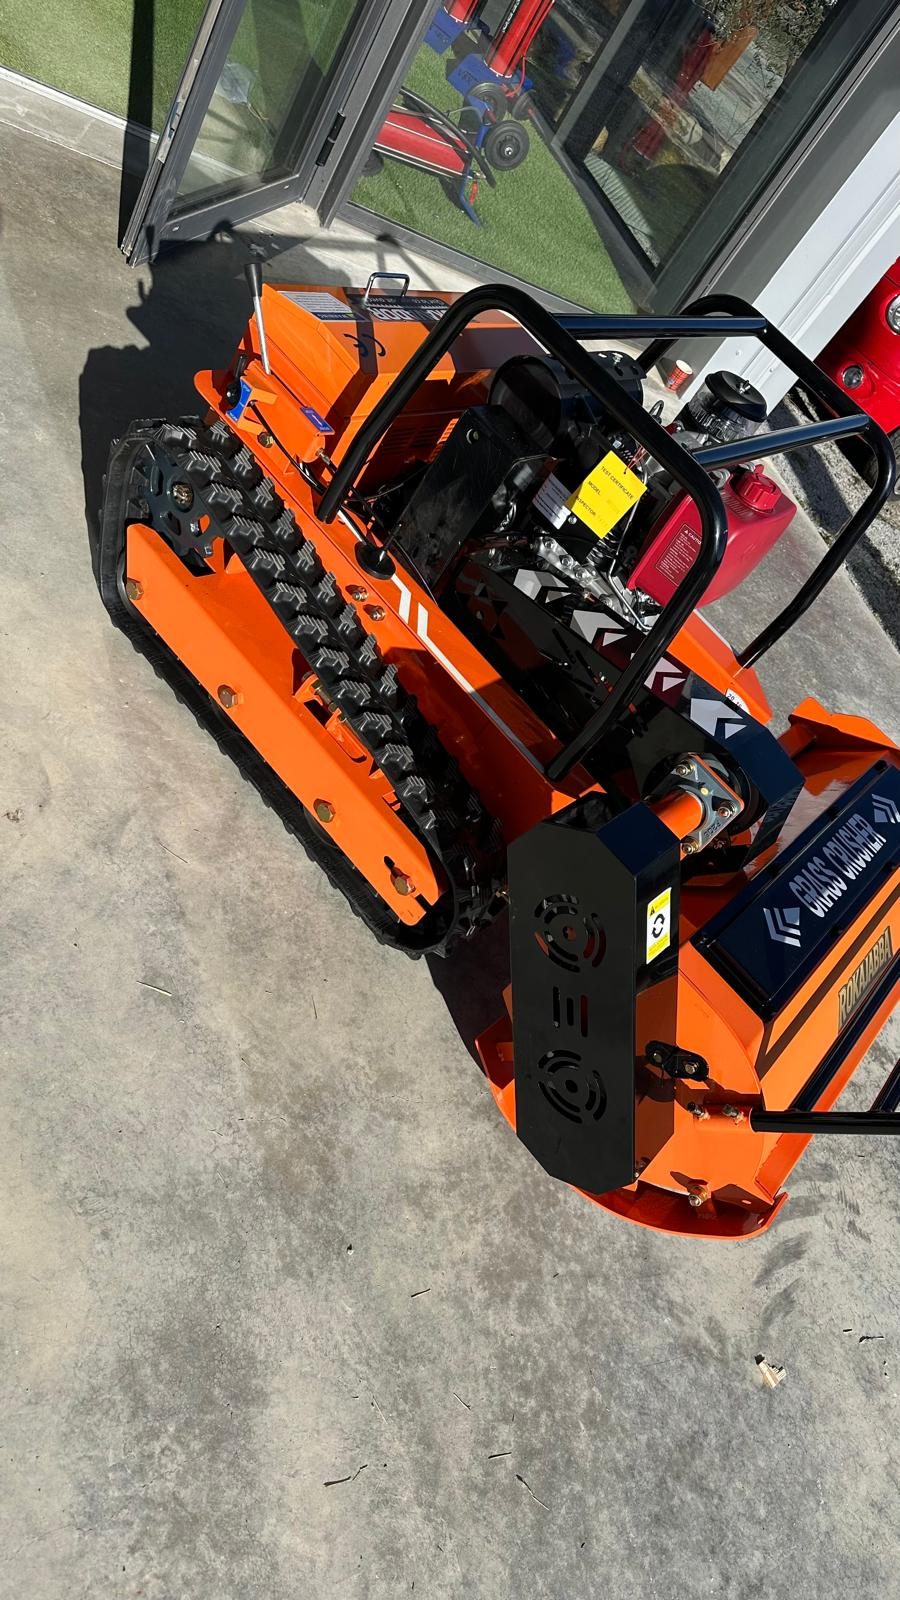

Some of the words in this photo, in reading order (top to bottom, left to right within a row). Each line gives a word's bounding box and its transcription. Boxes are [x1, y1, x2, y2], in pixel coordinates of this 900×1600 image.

[588, 480, 601, 495] MODEL
[601, 466, 611, 477] TEST
[609, 475, 634, 500] CERTIFICATE
[688, 532, 702, 545] CAUTIO
[788, 855, 848, 918] GRASS
[822, 813, 887, 880] CRUSHER
[838, 926, 894, 1029] ROKAJABBA
